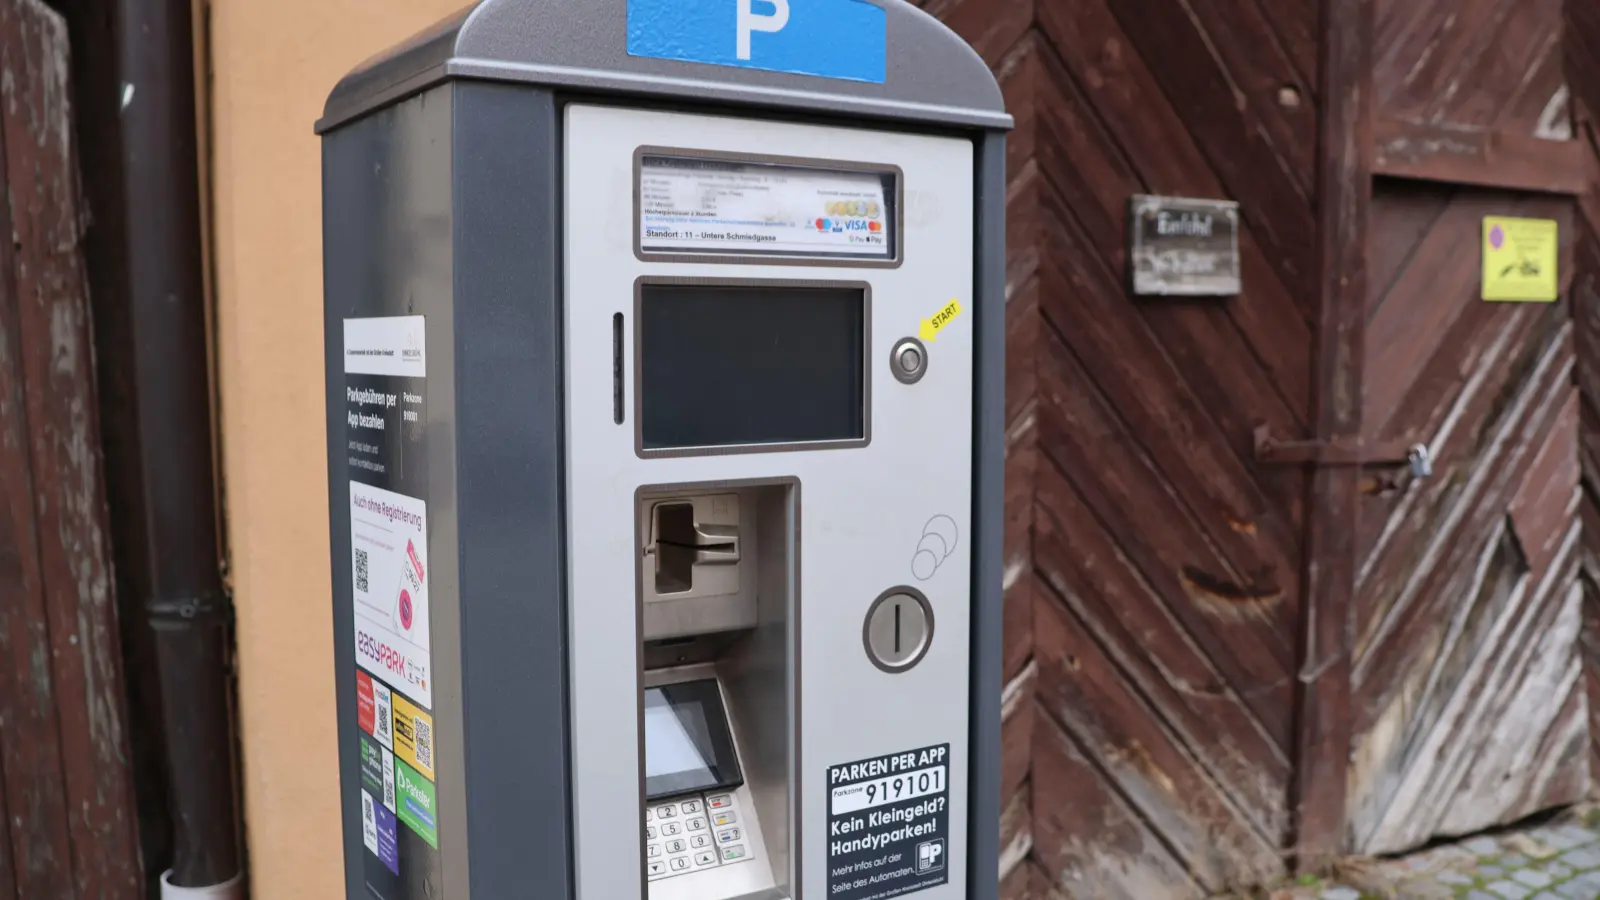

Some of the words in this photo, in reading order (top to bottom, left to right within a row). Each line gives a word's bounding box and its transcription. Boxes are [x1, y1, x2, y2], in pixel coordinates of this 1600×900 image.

[736, 0, 790, 60] P
[646, 229, 678, 238] Standort
[685, 231, 693, 239] 11
[701, 232, 725, 240] Untere
[726, 232, 777, 242] Schmiedgasse
[845, 219, 867, 231] VISA
[931, 303, 957, 329] START
[346, 386, 386, 406] Parkgebühren
[386, 393, 397, 409] per
[348, 410, 359, 428] App
[359, 411, 385, 430] bezahlen
[354, 494, 367, 509] Auch
[368, 497, 381, 514] ohne
[382, 501, 422, 532] Registrierung
[831, 758, 888, 784] PARKEN
[891, 753, 916, 772] PER
[918, 747, 946, 766] APP
[833, 786, 863, 798] Parkzone
[866, 770, 940, 804] 919101
[665, 807, 672, 816] 2
[689, 803, 696, 812] 3
[831, 817, 864, 837] Kein
[868, 797, 946, 828] Kleingeld?
[669, 824, 676, 834] 5
[693, 819, 700, 829] 6
[831, 818, 937, 857] Handyparken!
[649, 846, 655, 856] 7
[673, 841, 680, 851] 8
[697, 836, 704, 846] 9
[678, 859, 685, 868] 0
[832, 865, 854, 877] Mehr
[854, 860, 873, 872] Infos
[873, 855, 888, 867] auf
[888, 853, 903, 863] der
[831, 882, 852, 894] Seite
[853, 879, 868, 889] des
[868, 867, 915, 884] Automaten.
